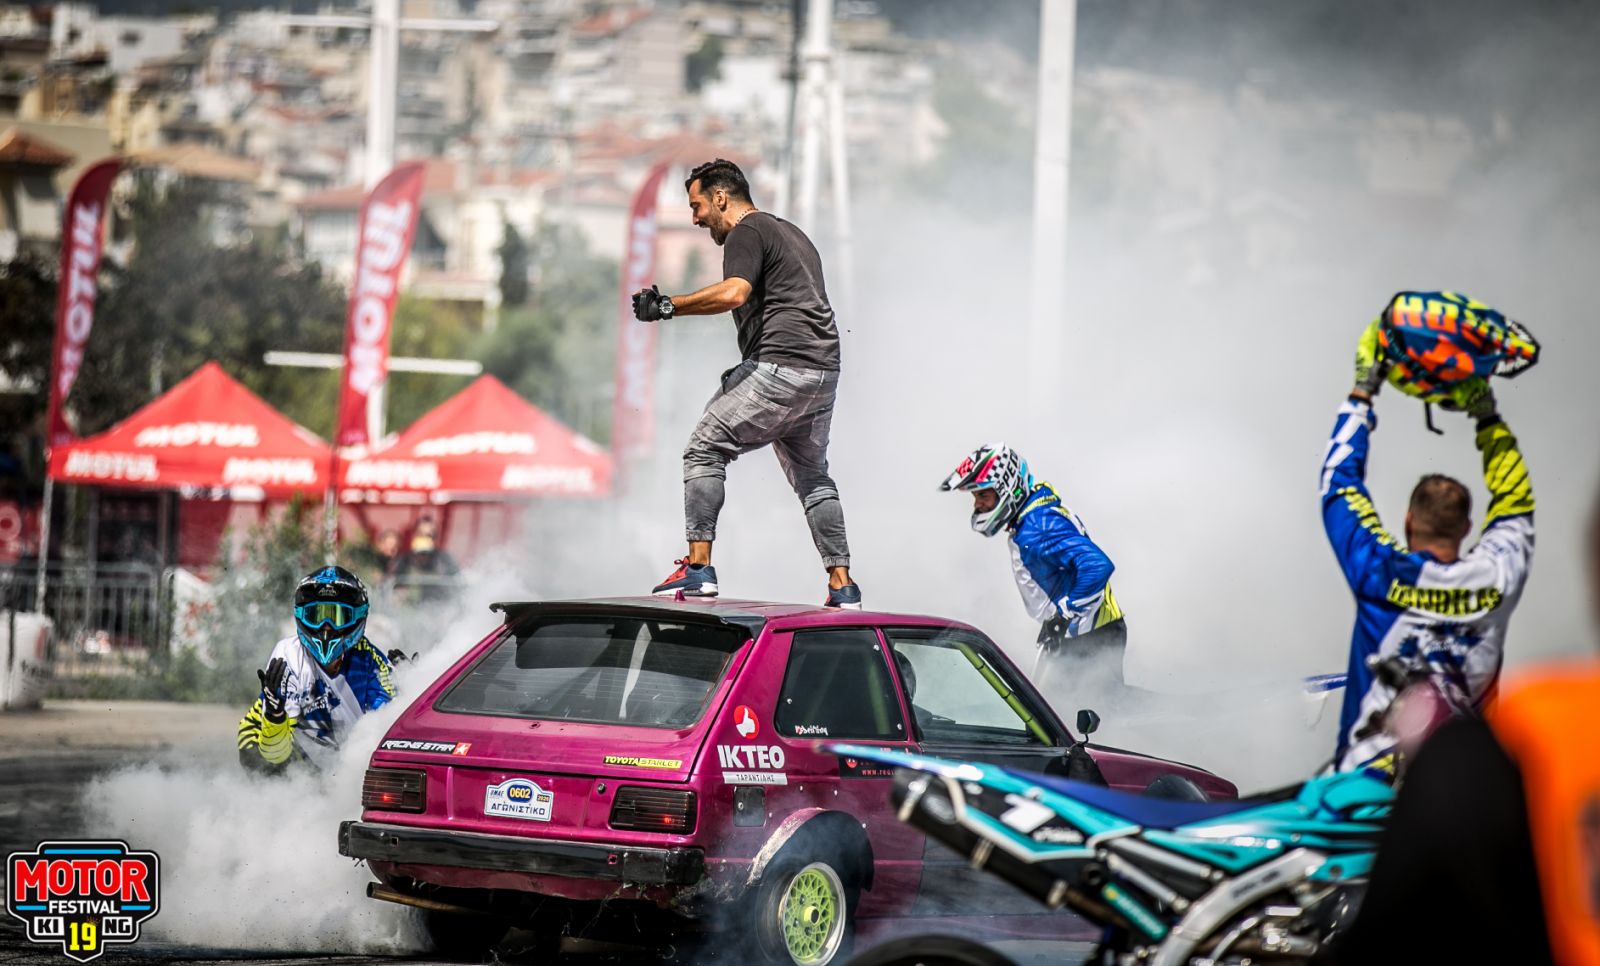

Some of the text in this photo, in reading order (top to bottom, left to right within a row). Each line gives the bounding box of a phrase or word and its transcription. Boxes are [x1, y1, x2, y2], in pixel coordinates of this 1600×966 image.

[350, 200, 415, 396] MOTUL
[135, 422, 260, 447] MOTUL
[64, 451, 159, 482] MOTUL
[222, 458, 317, 484] MOTUL
[382, 740, 456, 752] RACING STAR
[509, 787, 531, 799] 0602
